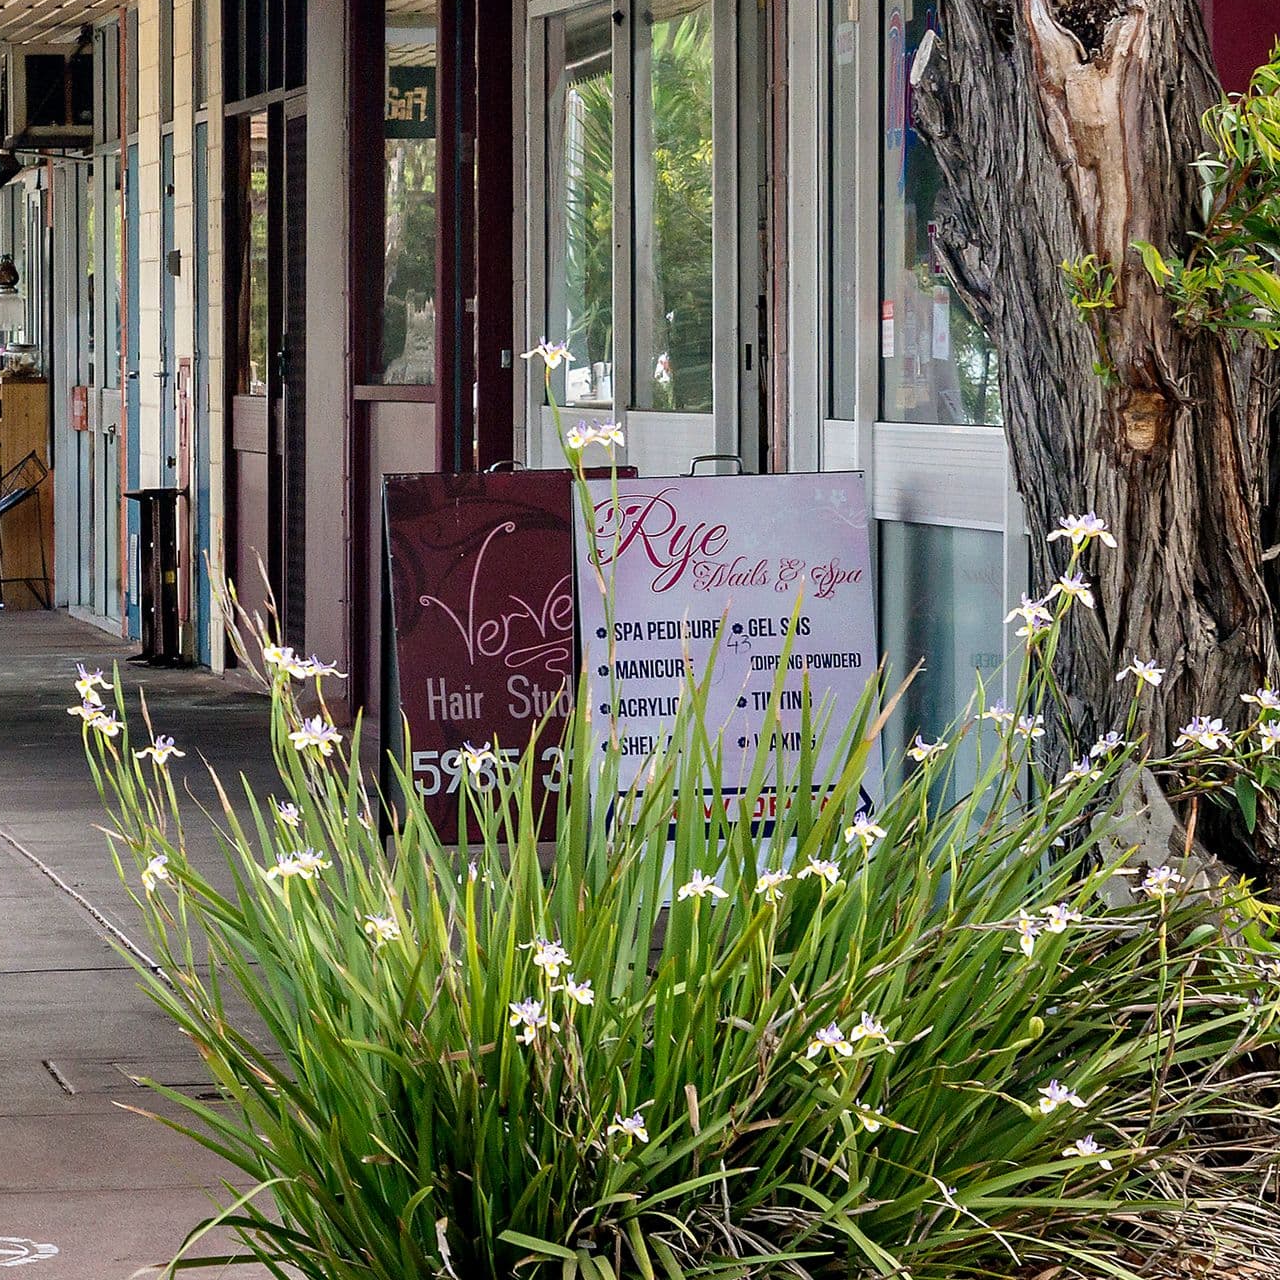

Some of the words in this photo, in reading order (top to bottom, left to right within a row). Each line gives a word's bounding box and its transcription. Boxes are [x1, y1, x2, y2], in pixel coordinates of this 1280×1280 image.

[587, 488, 728, 593] Rye
[692, 556, 769, 592] Nails
[810, 557, 863, 599] Spa
[614, 622, 644, 641] SPA
[748, 619, 777, 637] GEL
[750, 655, 803, 670] (DIPPNG
[806, 653, 862, 669] POWDER)
[426, 677, 485, 721] Hair
[754, 732, 817, 752] AXIN
